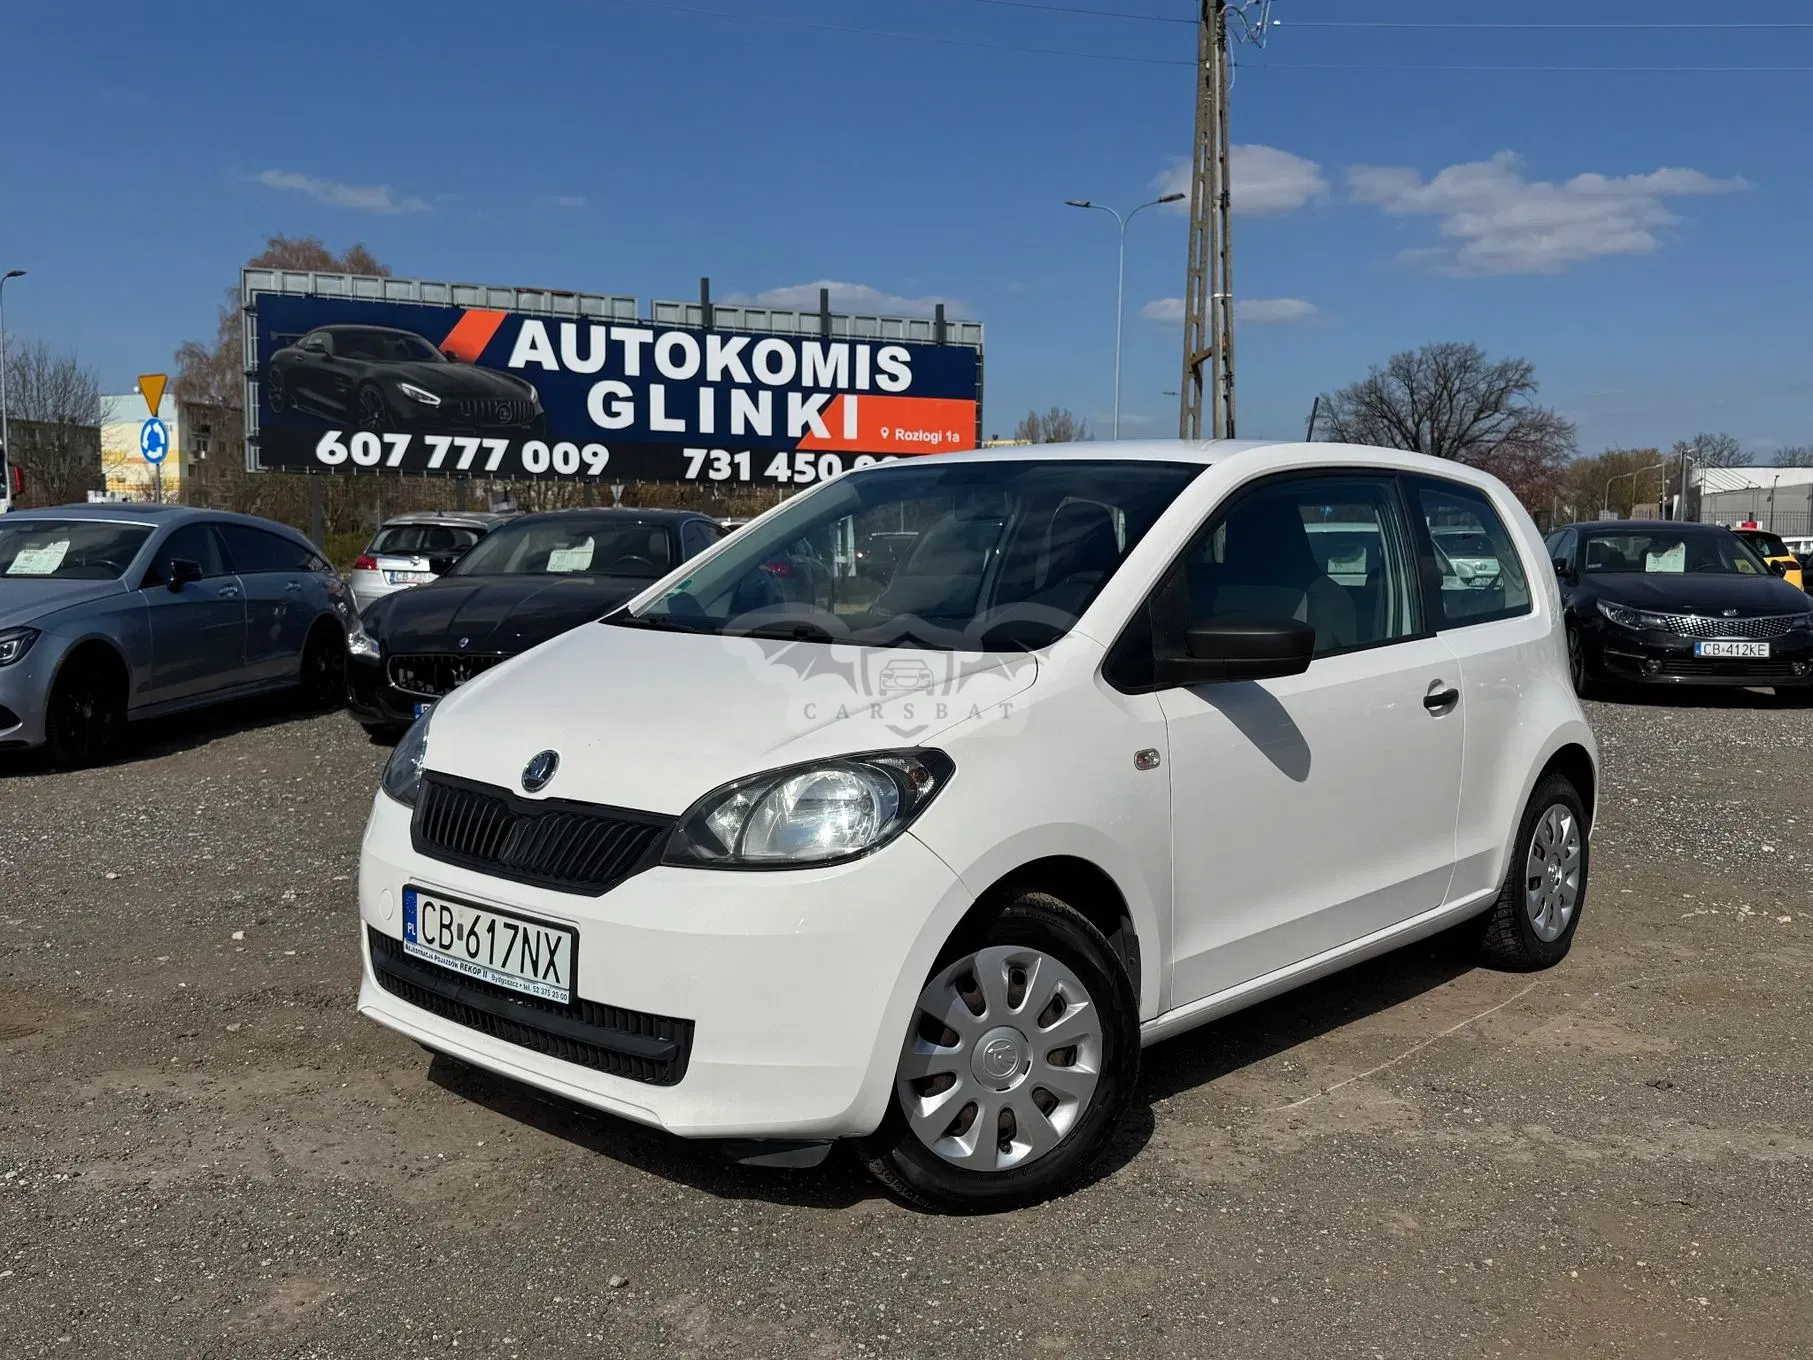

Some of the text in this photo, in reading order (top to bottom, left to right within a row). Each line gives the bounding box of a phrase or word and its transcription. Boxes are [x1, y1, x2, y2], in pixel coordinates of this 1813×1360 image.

[508, 318, 912, 393] AUTOKOMIS
[586, 380, 859, 440] GLINKI
[315, 430, 610, 476] 607 777 009
[946, 429, 960, 443] 1a
[683, 448, 750, 481] 731
[764, 452, 842, 482] 450
[1703, 643, 1766, 656] CB 412KE
[407, 921, 416, 936] PL
[422, 900, 562, 984] CB 617NX
[459, 962, 482, 976] REKOP
[532, 985, 540, 994] 52
[540, 987, 551, 996] 375
[551, 990, 560, 999] 23
[560, 992, 569, 1001] 00
